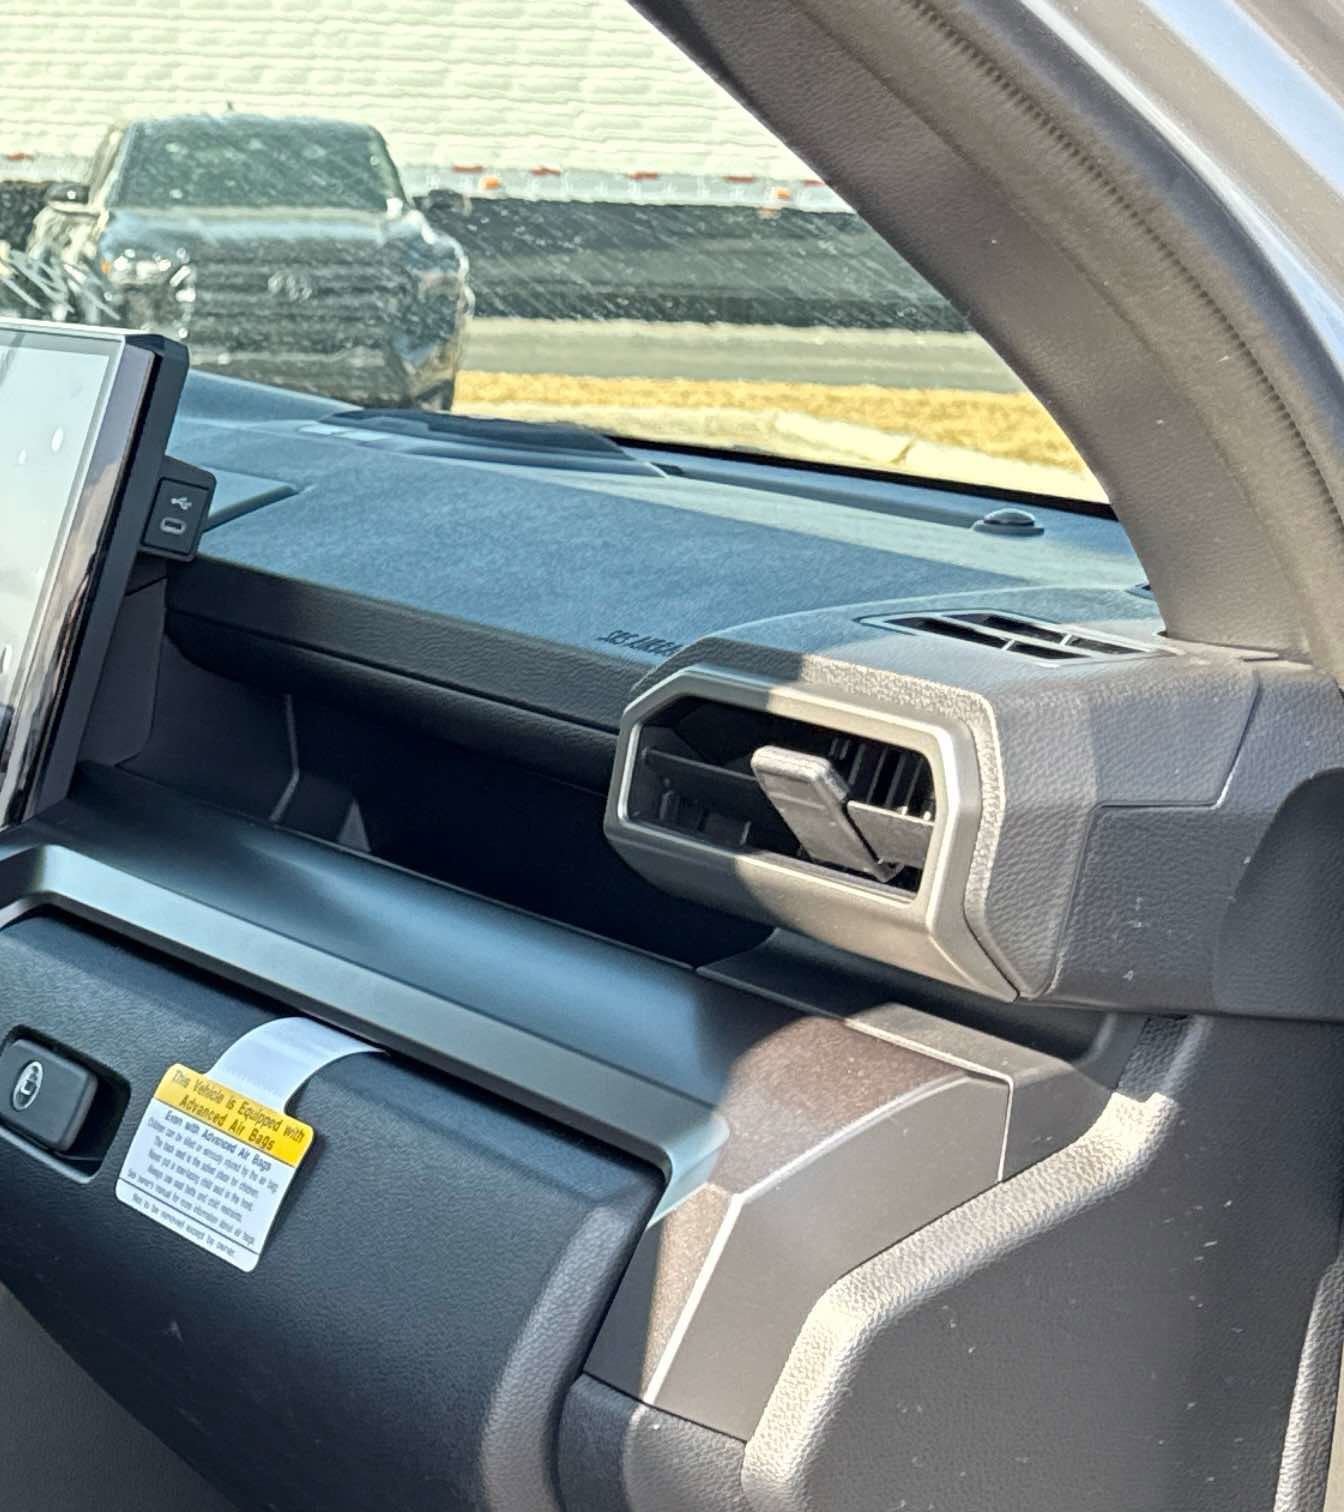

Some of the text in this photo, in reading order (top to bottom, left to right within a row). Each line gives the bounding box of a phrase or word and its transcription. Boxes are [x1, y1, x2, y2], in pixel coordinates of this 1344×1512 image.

[180, 1095, 277, 1152] Advanced Air Bags
[193, 1080, 226, 1104] Vehicle
[227, 1096, 237, 1109] is
[238, 1102, 283, 1134] Equipped
[284, 1125, 306, 1143] with
[202, 1129, 238, 1153] Advanced
[251, 1154, 274, 1174] Bags
